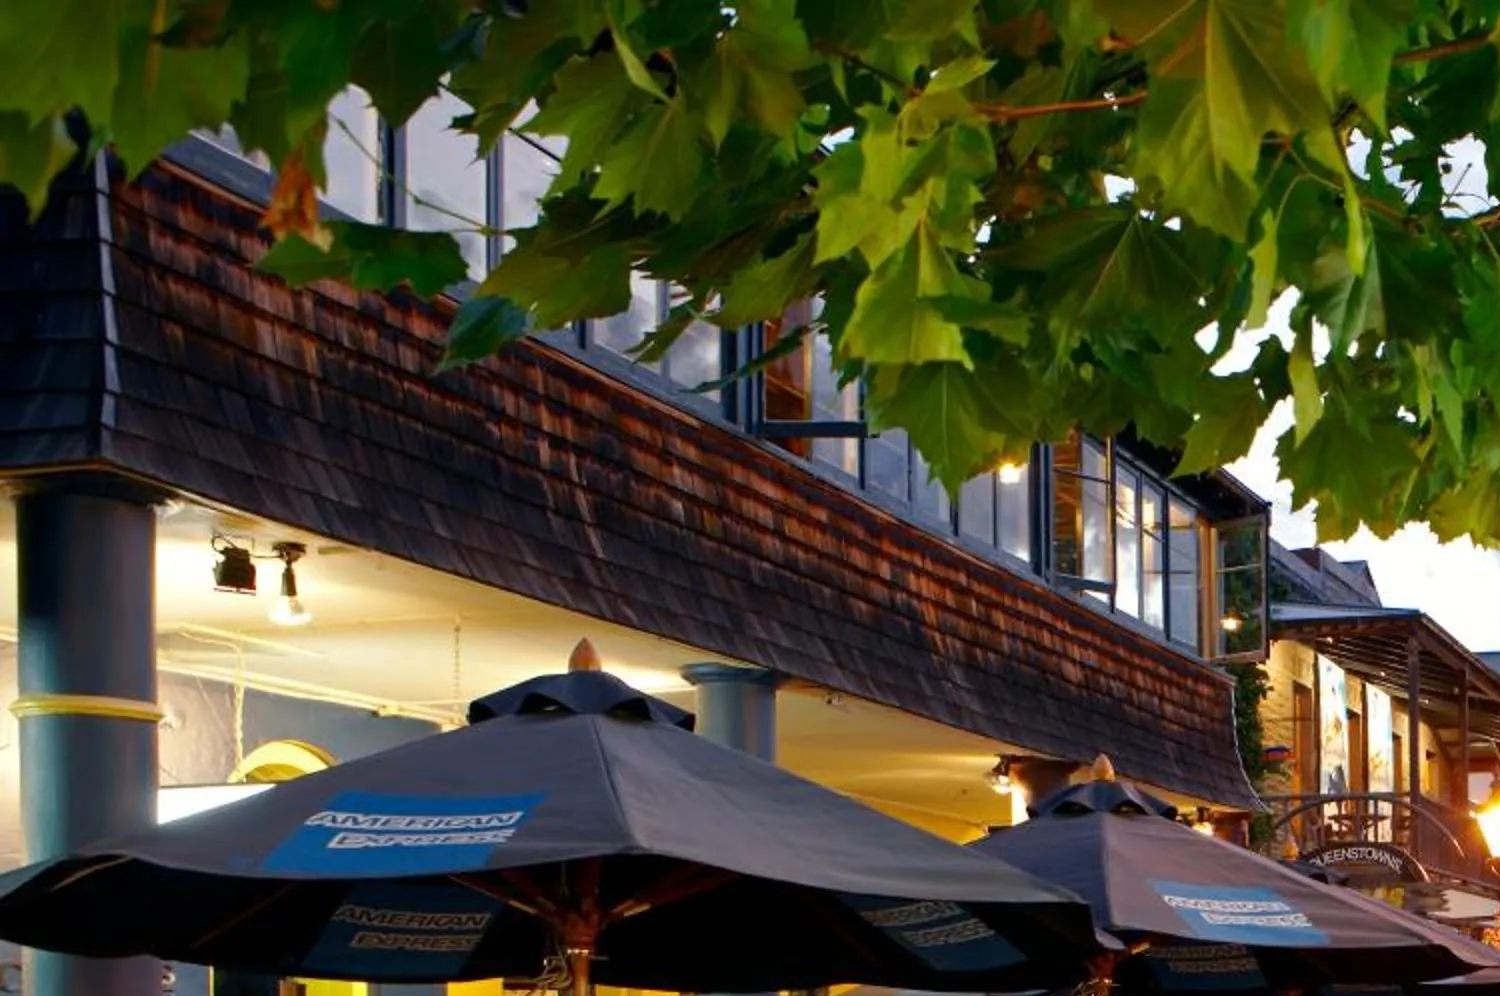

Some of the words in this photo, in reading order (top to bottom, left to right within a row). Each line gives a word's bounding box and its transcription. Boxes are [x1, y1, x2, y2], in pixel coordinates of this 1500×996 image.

[304, 811, 525, 830] AMERICAN
[327, 828, 517, 849] EXPRESS
[331, 904, 493, 930] AMERICAN
[349, 930, 486, 952] EXPRESS
